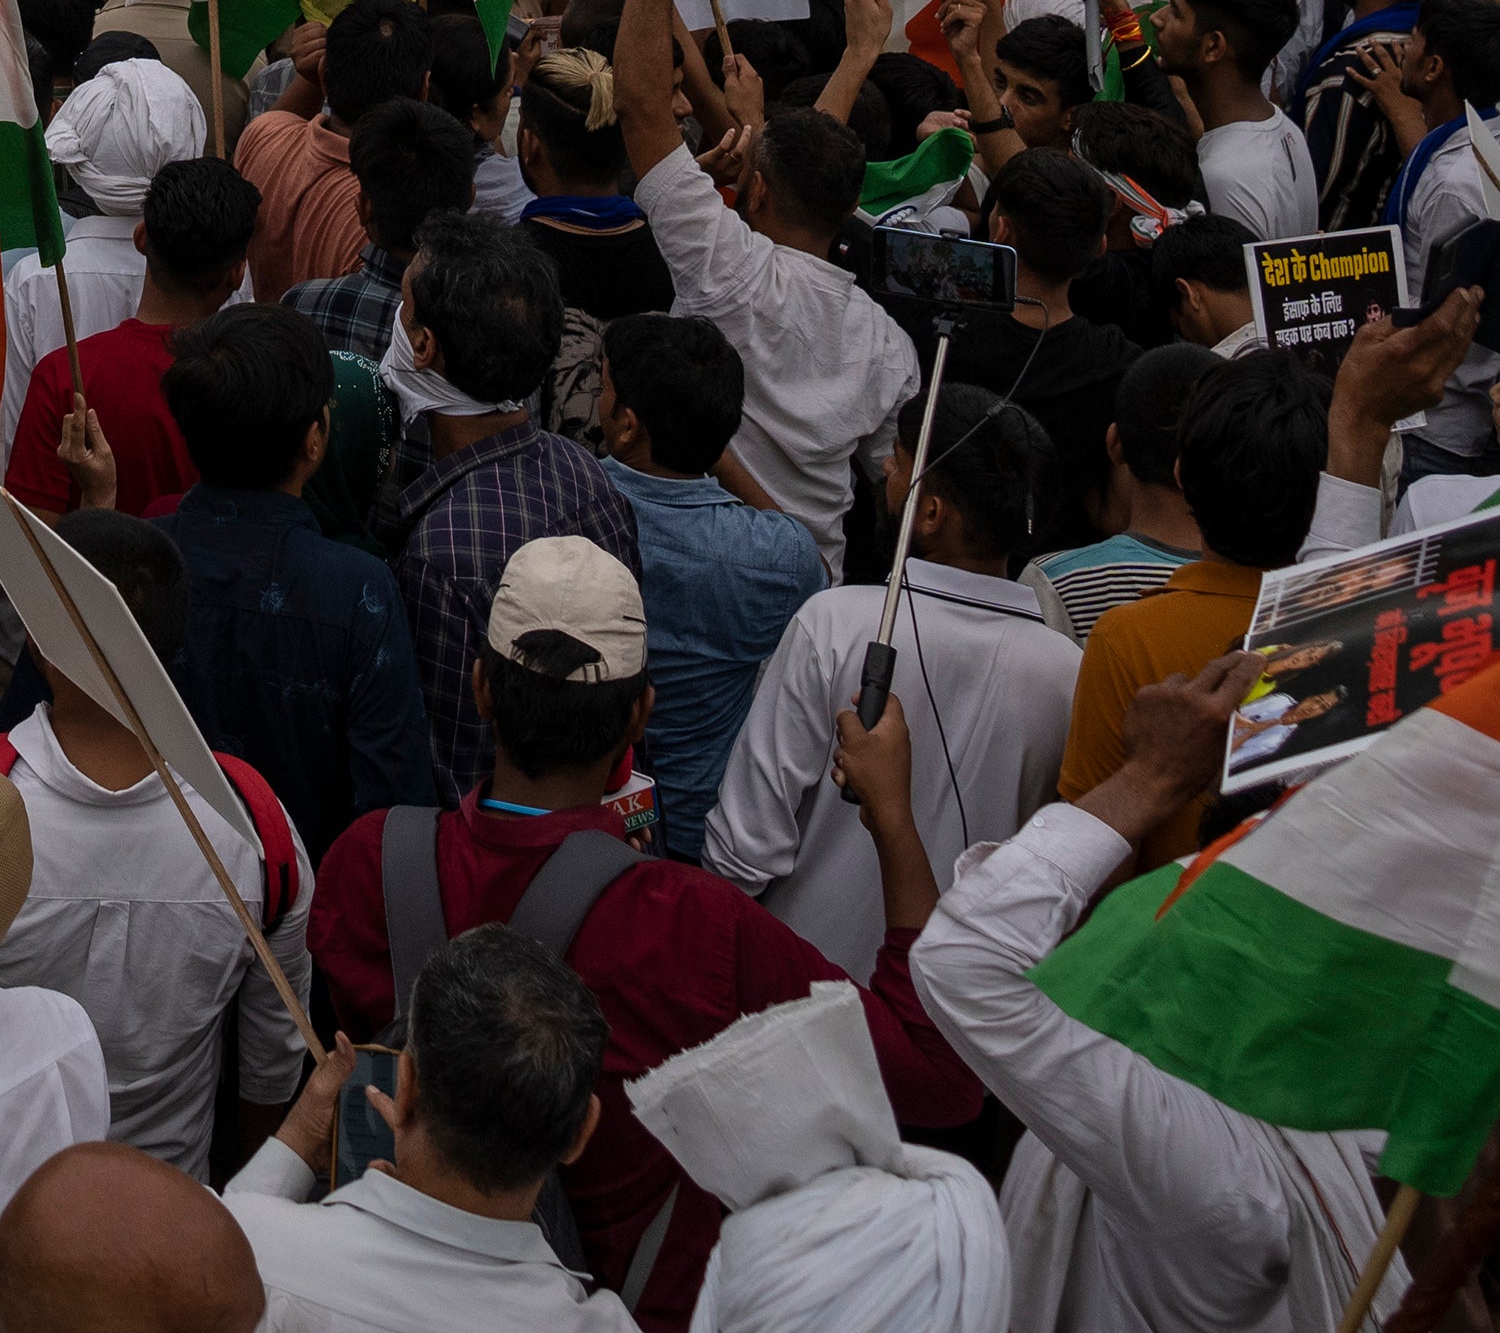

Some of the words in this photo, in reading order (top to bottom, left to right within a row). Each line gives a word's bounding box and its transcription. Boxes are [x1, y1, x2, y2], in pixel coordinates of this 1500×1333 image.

[1261, 251, 1291, 288] देश
[1290, 247, 1308, 284] के
[1308, 246, 1390, 282] Champion
[1310, 293, 1321, 316] के
[1321, 290, 1343, 315] लिए
[1300, 325, 1313, 343] पर
[1313, 321, 1331, 341] कब
[1331, 319, 1348, 338] तक
[607, 792, 645, 816] AK
